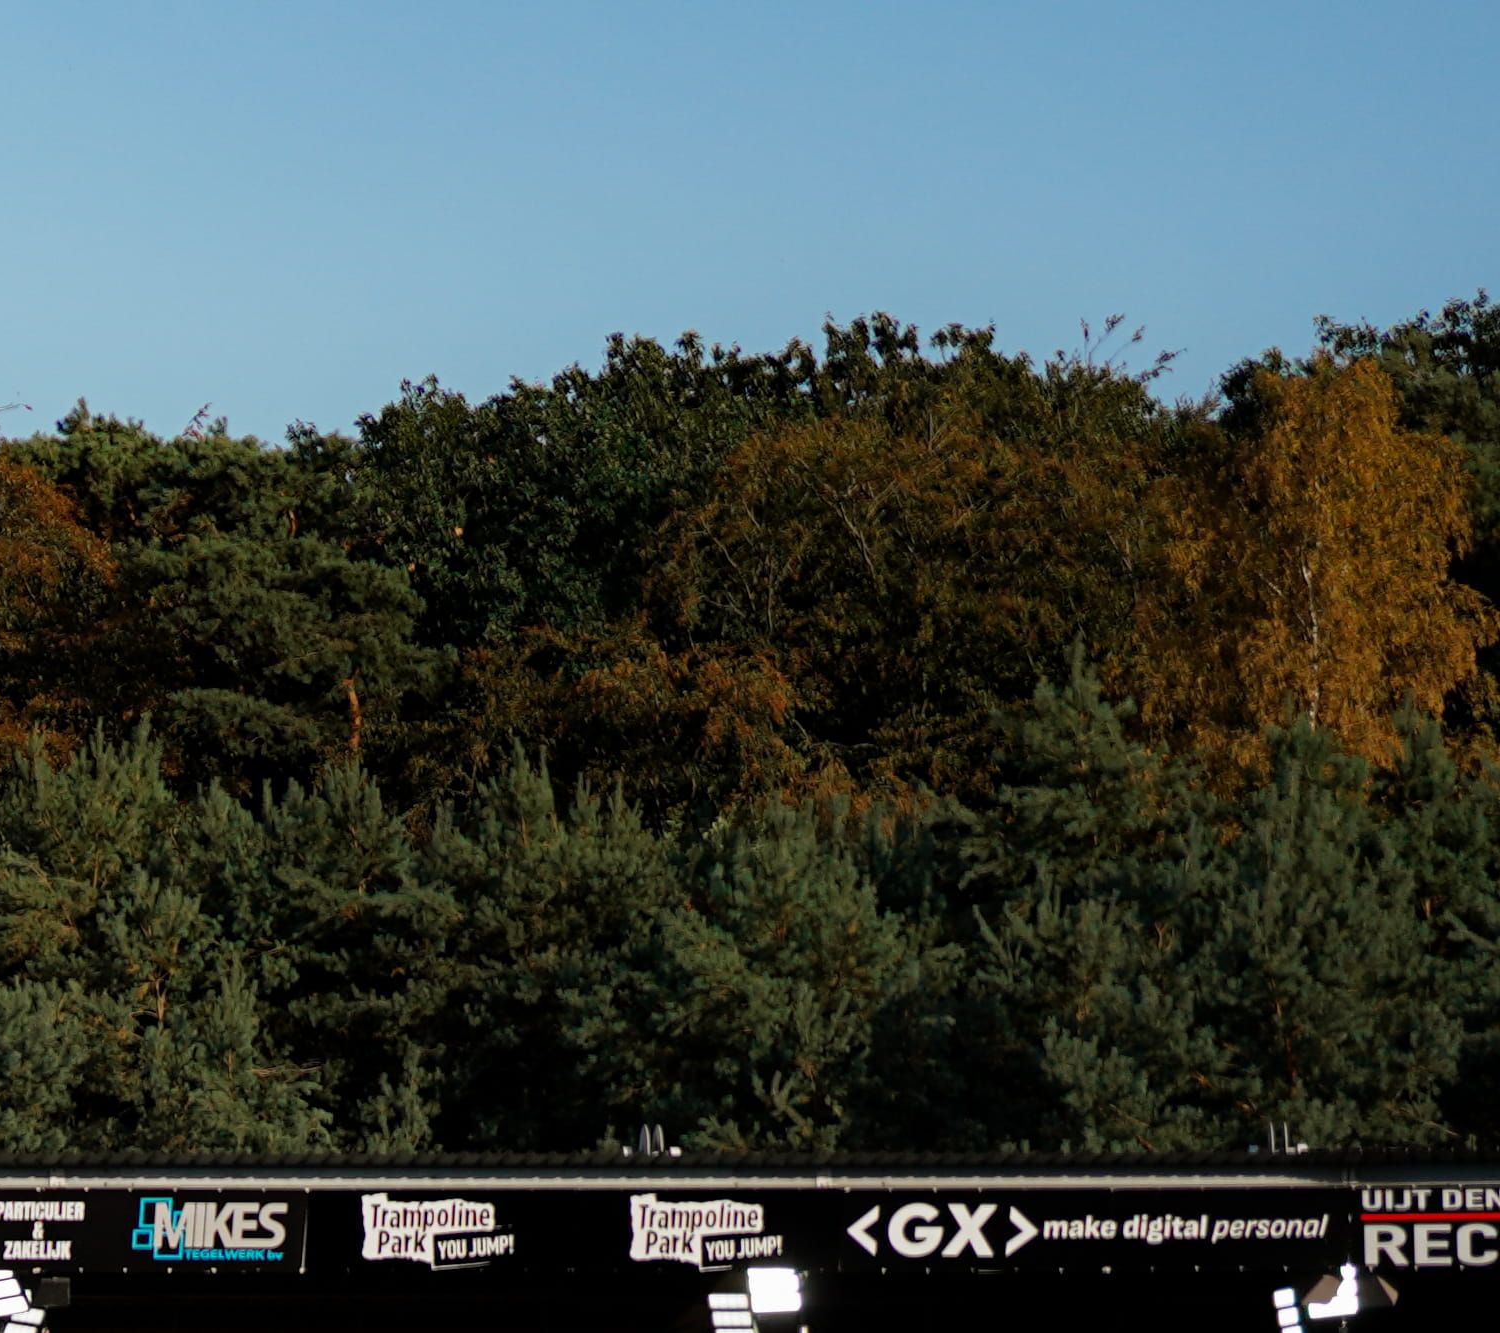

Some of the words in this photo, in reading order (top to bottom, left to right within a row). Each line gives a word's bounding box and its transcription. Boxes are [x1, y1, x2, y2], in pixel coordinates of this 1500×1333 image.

[1361, 1189, 1432, 1212] UIJT
[153, 1202, 287, 1248] MIKES
[371, 1203, 491, 1231] Trampoline
[639, 1203, 759, 1231] Trampoline
[1043, 1215, 1117, 1239] make
[1123, 1214, 1208, 1244] digital
[1212, 1214, 1328, 1243] personal
[31, 1221, 46, 1240] &
[377, 1231, 426, 1254] Park
[645, 1231, 694, 1254] Park
[3, 1240, 71, 1260] ZAKELIJK
[184, 1249, 265, 1260] TEGELWERK
[437, 1239, 467, 1261] YOU
[468, 1234, 515, 1257] JUMP!
[705, 1239, 735, 1261] YOU
[736, 1235, 783, 1258] JUMP!
[1363, 1223, 1498, 1267] REC
